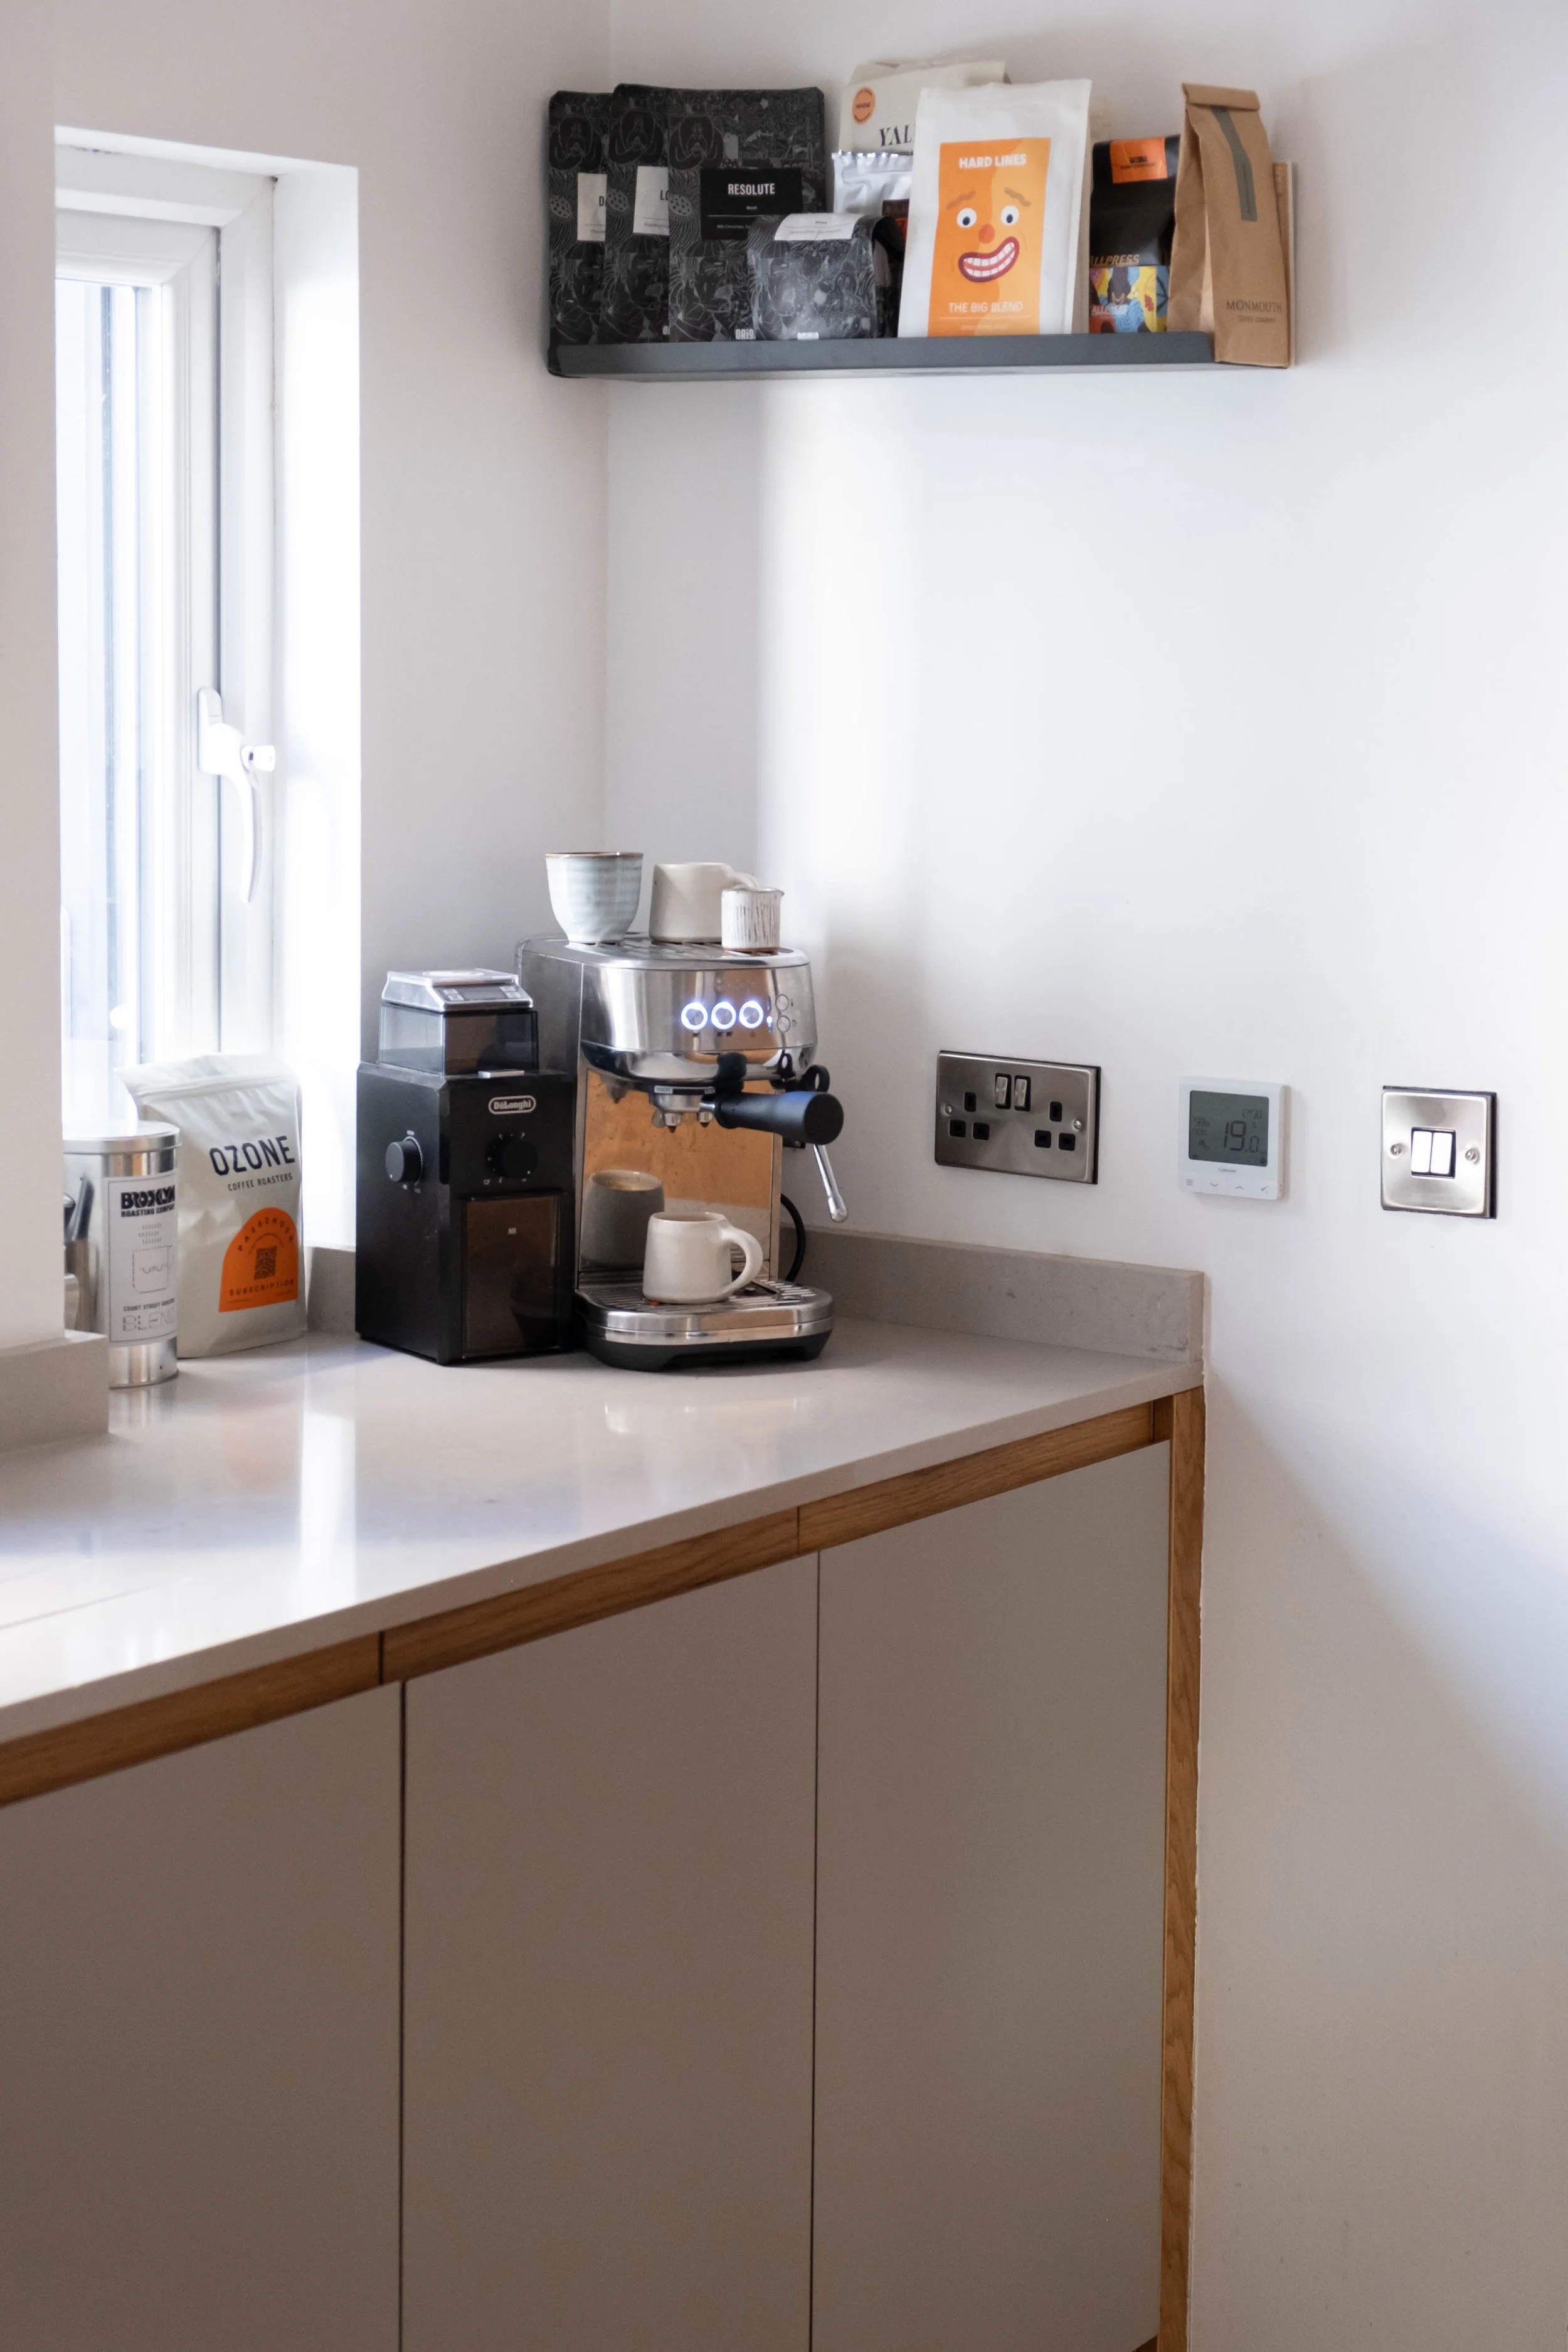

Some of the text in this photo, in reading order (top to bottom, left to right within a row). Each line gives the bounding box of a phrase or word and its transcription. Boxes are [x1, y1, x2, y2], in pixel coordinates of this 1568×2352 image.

[879, 125, 915, 146] YAL
[959, 153, 1027, 169] HARD LINES
[728, 183, 775, 196] RESOLUTE
[948, 300, 1024, 314] THE BIG BLEND
[1226, 299, 1282, 313] MONMOUTH
[209, 1135, 295, 1176] OZONE
[228, 1173, 293, 1191] COFFEE ROASTERS
[120, 1185, 176, 1210] BROOKLYN
[120, 1208, 156, 1217] ROASTING
[238, 1216, 294, 1253] PASSENGER
[229, 1279, 294, 1296] SUBSCRIPTION
